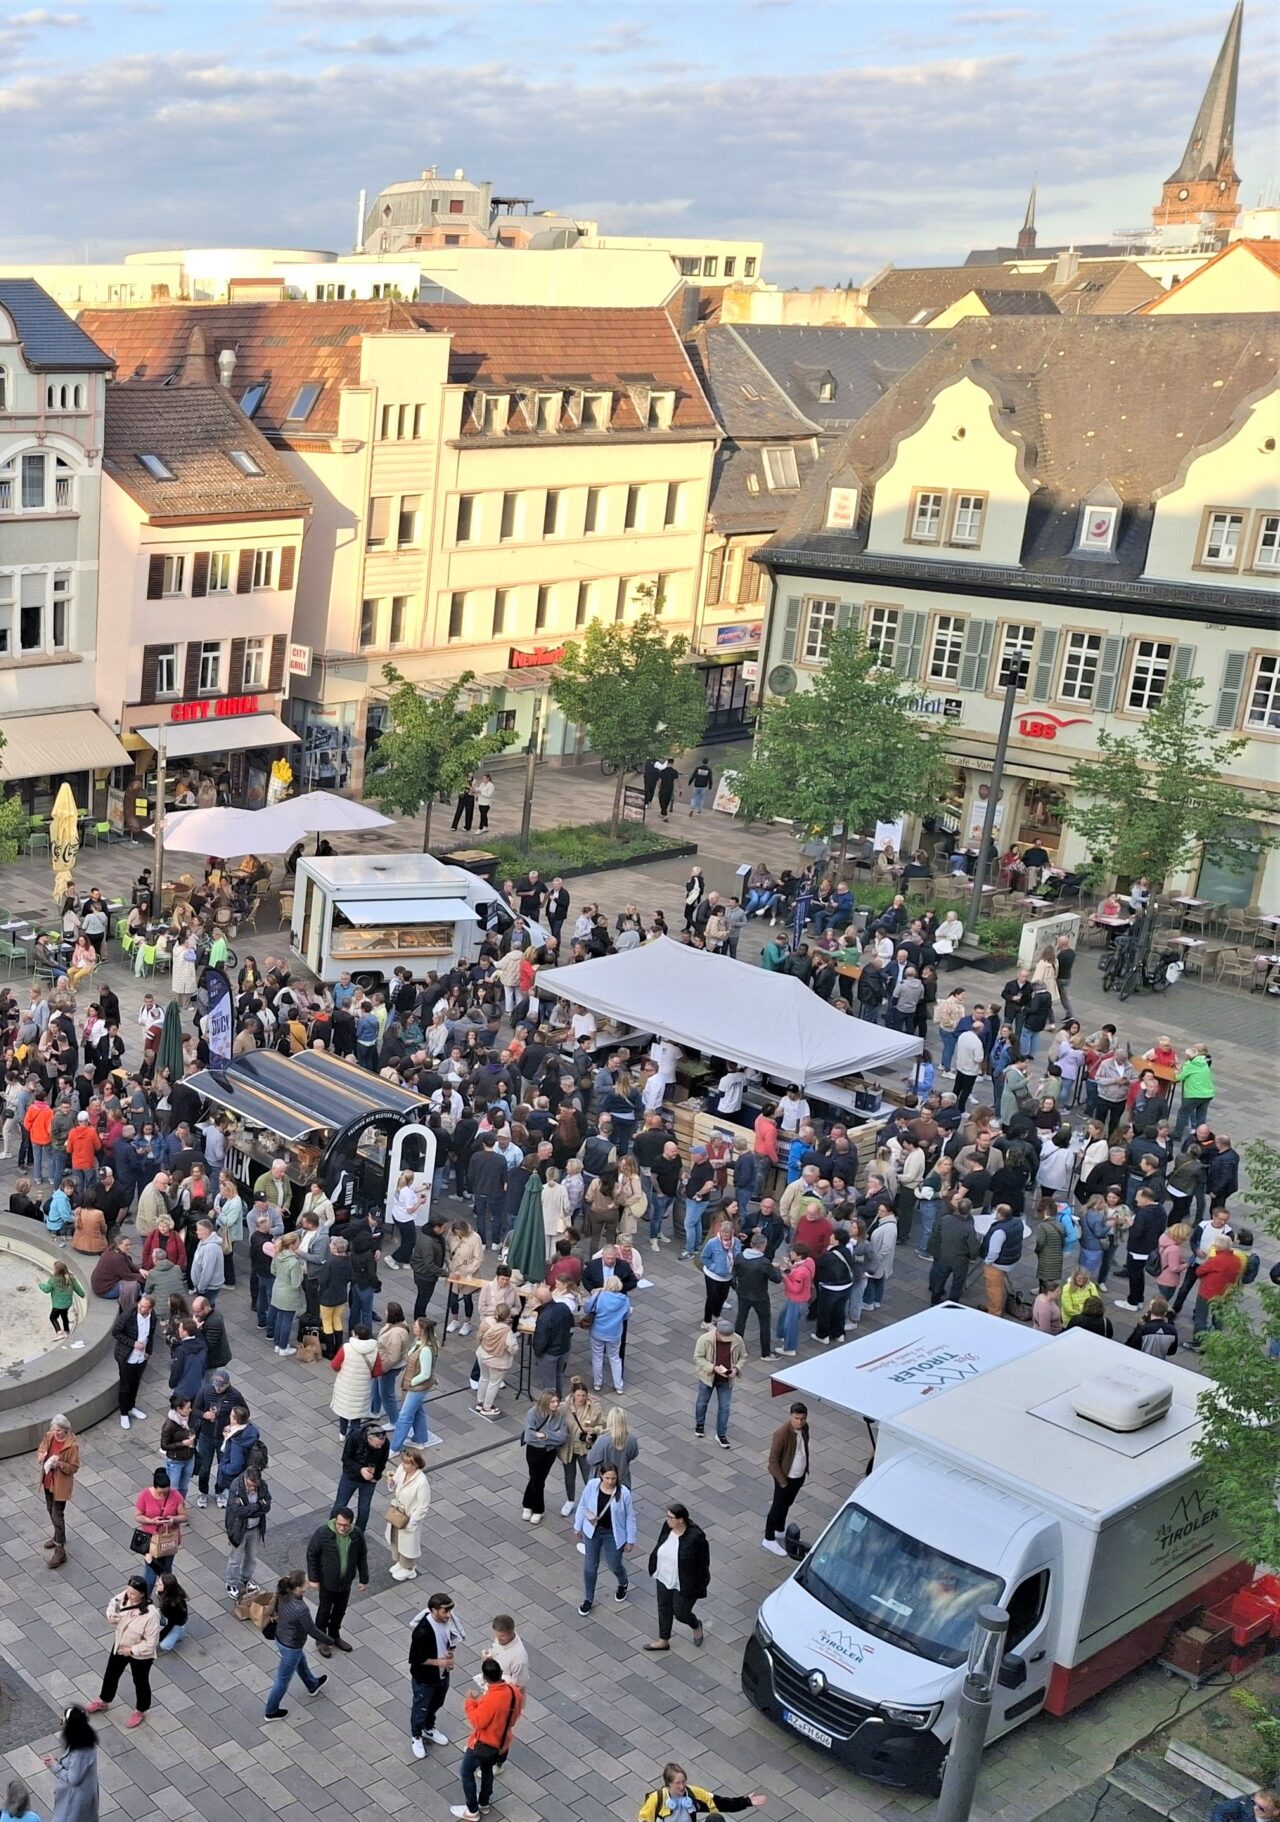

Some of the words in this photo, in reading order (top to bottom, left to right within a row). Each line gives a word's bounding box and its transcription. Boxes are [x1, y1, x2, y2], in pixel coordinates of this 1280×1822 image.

[290, 660, 307, 672] GRILL
[292, 647, 307, 659] CITY
[171, 701, 210, 721] CITY
[215, 695, 259, 716] GRILL
[1019, 719, 1057, 740] LBS
[211, 1014, 230, 1036] DUCK
[223, 1147, 252, 1186] UCK
[887, 1351, 960, 1384] TIROLER
[1160, 1506, 1220, 1551] TIROLER
[820, 1635, 864, 1664] TIROLER
